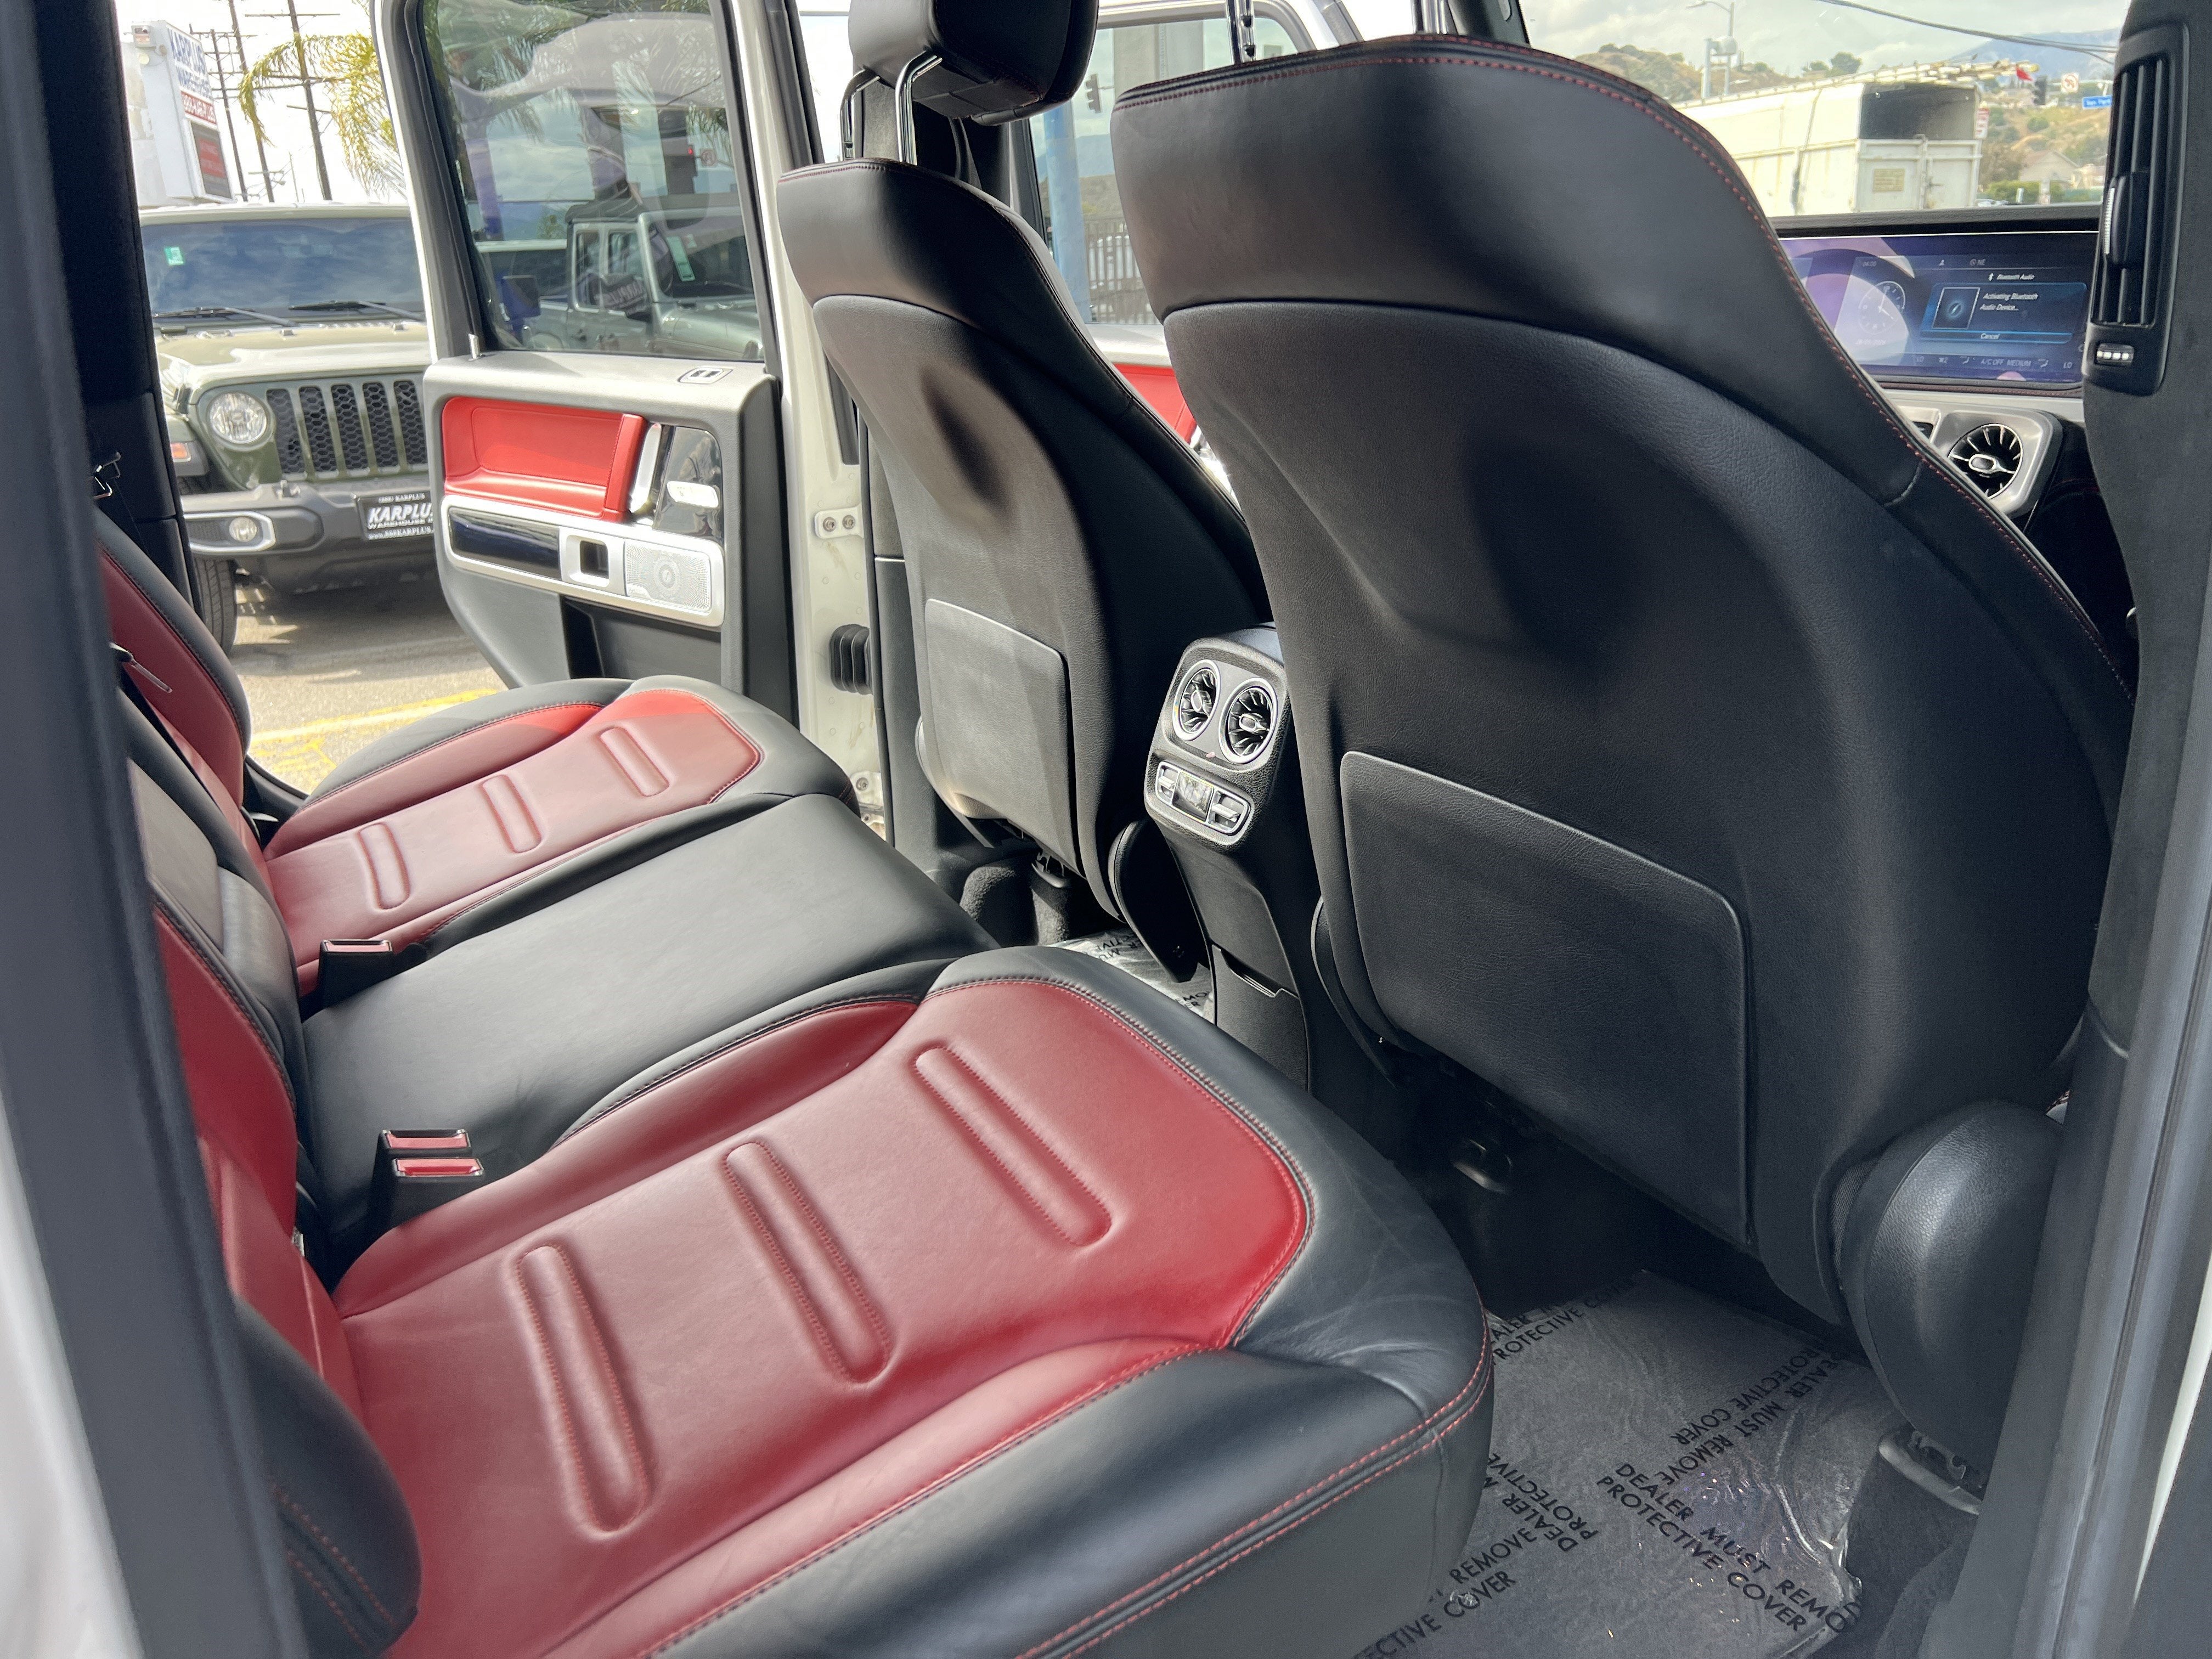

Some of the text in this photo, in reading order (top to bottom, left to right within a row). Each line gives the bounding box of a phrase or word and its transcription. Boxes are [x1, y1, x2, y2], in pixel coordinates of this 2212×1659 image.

[368, 503, 433, 524] KARPLU
[368, 518, 426, 530] WAREHOUSE
[395, 493, 425, 503] KARPLUS
[1493, 1305, 1585, 1361] ROTECTIVE
[1669, 1408, 1731, 1445] COVER
[1734, 1401, 1786, 1438] MUST
[1654, 1434, 1734, 1486] REMOVE
[1487, 1453, 1599, 1540] PROTECTIVE
[1501, 1492, 1579, 1552] DEALER
[1615, 1463, 1695, 1522] DEALER
[1700, 1526, 1771, 1574] MUST
[1449, 1527, 1537, 1584] REMOVE
[1595, 1475, 1807, 1632] PROTECTIVE COVER
[1443, 1571, 1517, 1618] COVER
